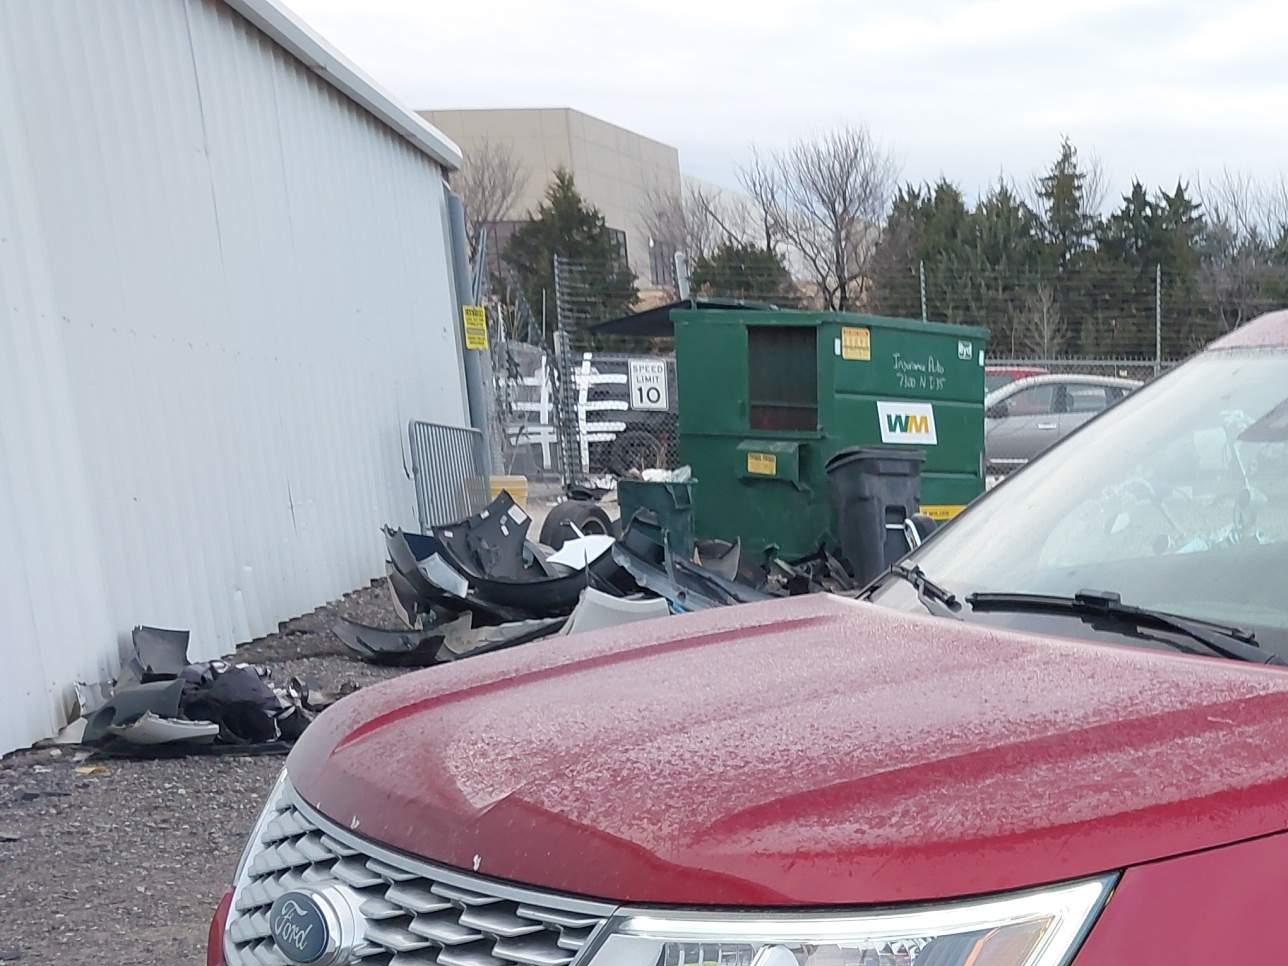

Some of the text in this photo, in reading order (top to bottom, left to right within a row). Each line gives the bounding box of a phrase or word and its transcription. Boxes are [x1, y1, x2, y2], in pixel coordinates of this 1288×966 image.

[636, 376, 658, 384] LIMIT
[638, 387, 660, 403] 10
[886, 413, 930, 433] WM
[274, 899, 313, 950] Ford
